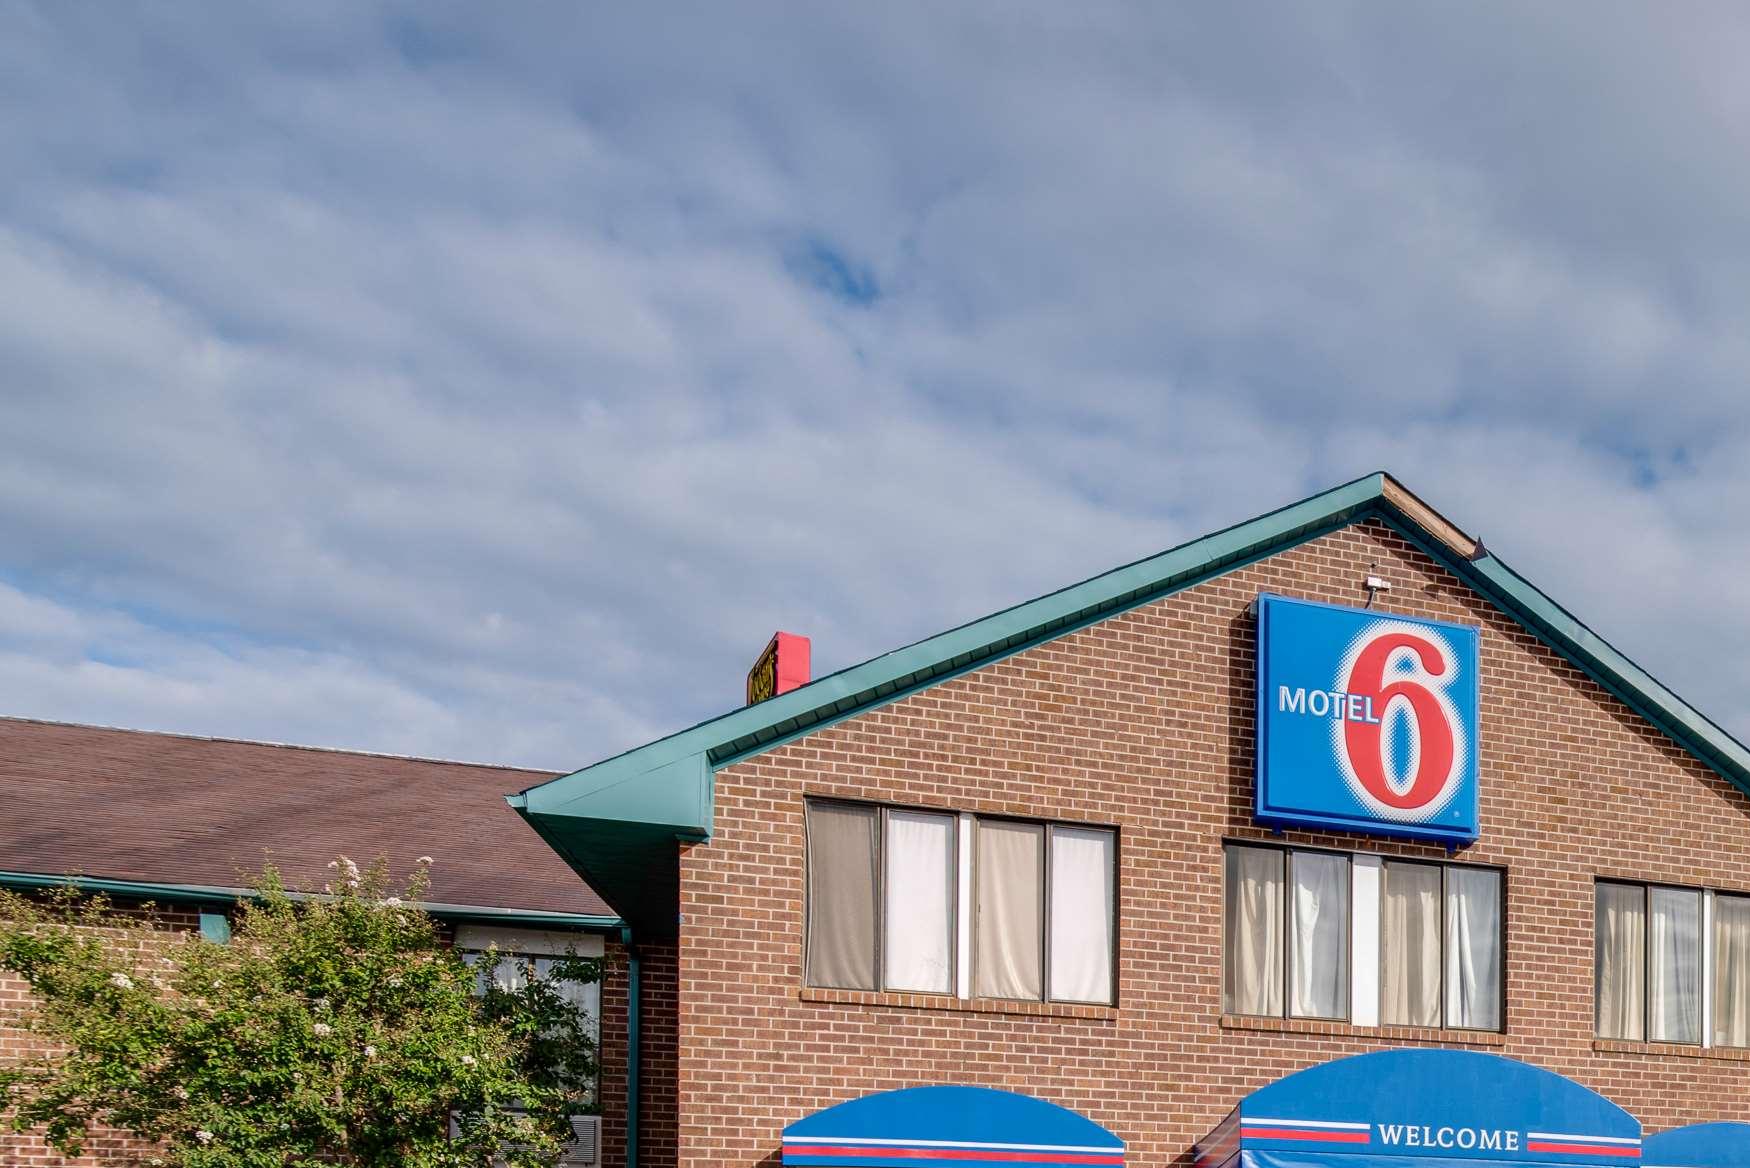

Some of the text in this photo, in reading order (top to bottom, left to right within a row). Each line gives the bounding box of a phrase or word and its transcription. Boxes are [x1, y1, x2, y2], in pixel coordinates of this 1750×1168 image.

[1279, 632, 1454, 810] MOTEL 6
[1377, 1123, 1520, 1152] WELCOME
